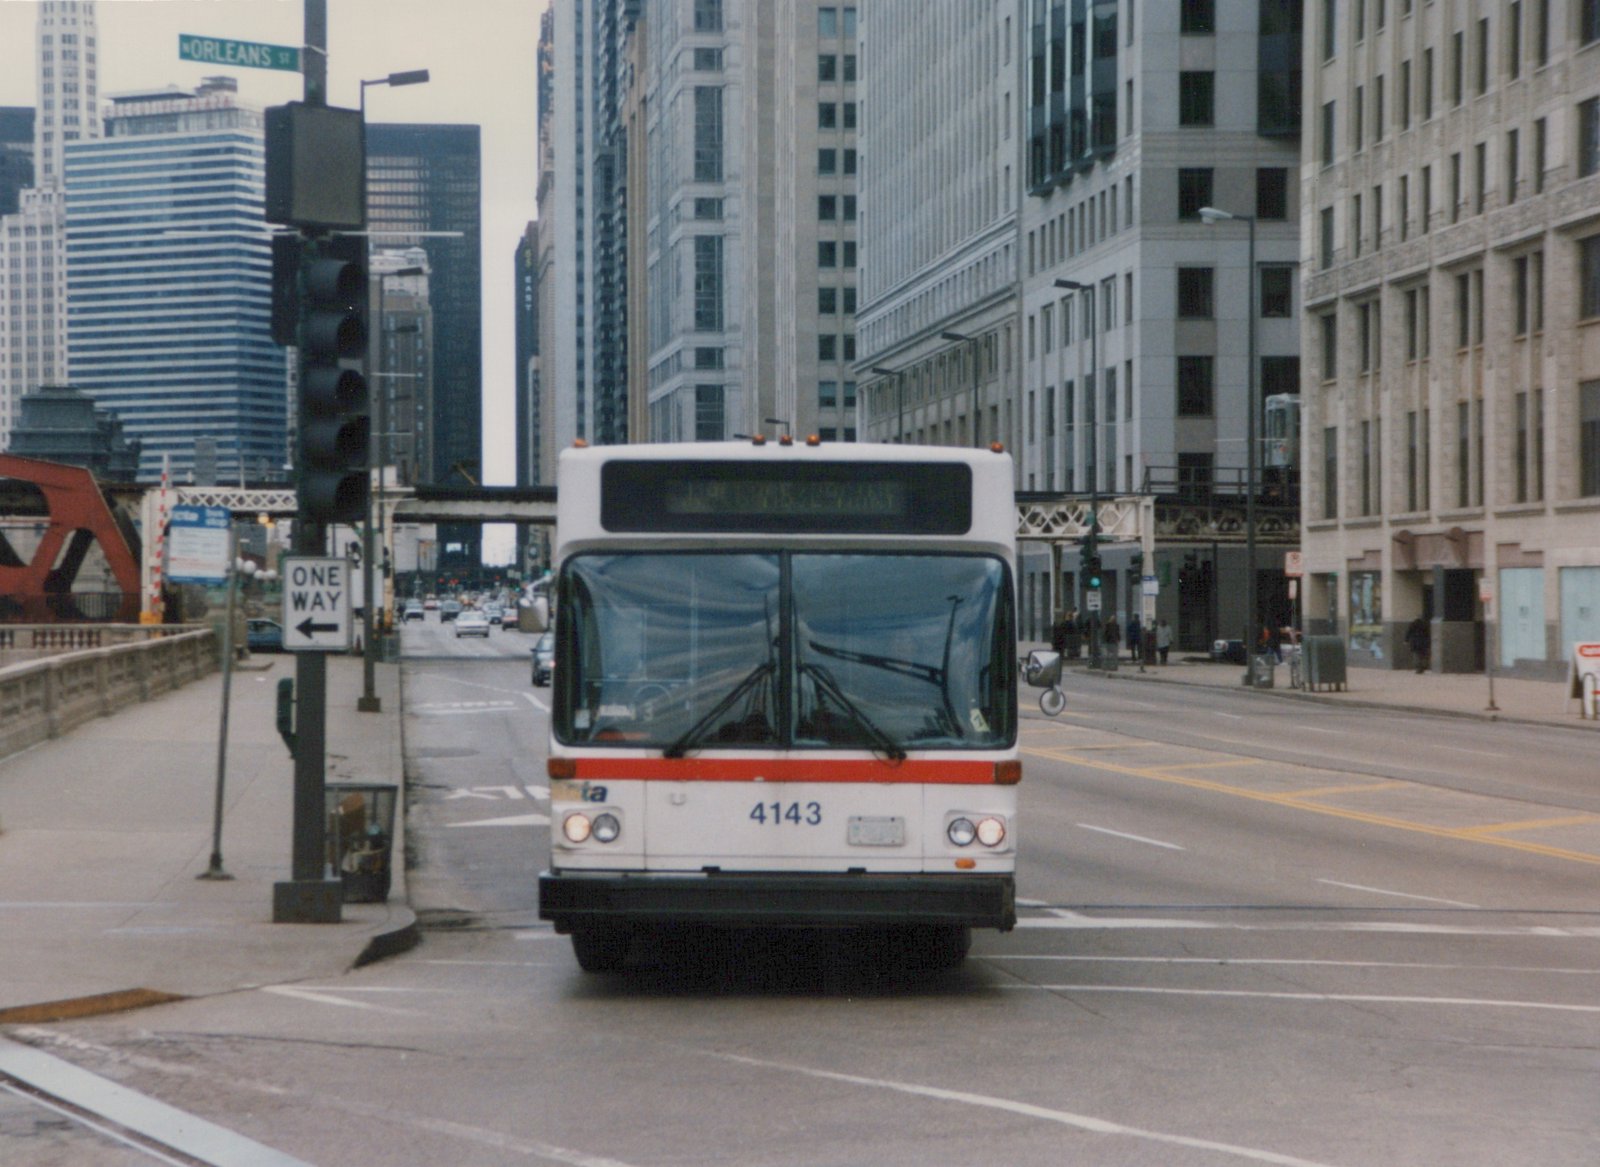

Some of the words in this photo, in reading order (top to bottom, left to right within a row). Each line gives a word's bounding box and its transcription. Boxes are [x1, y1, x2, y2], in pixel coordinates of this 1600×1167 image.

[191, 39, 272, 67] ORLEANS
[278, 51, 290, 65] ST
[292, 566, 341, 587] ONE
[291, 591, 342, 612] WAY
[570, 781, 609, 803] ta
[749, 801, 822, 826] 4143
